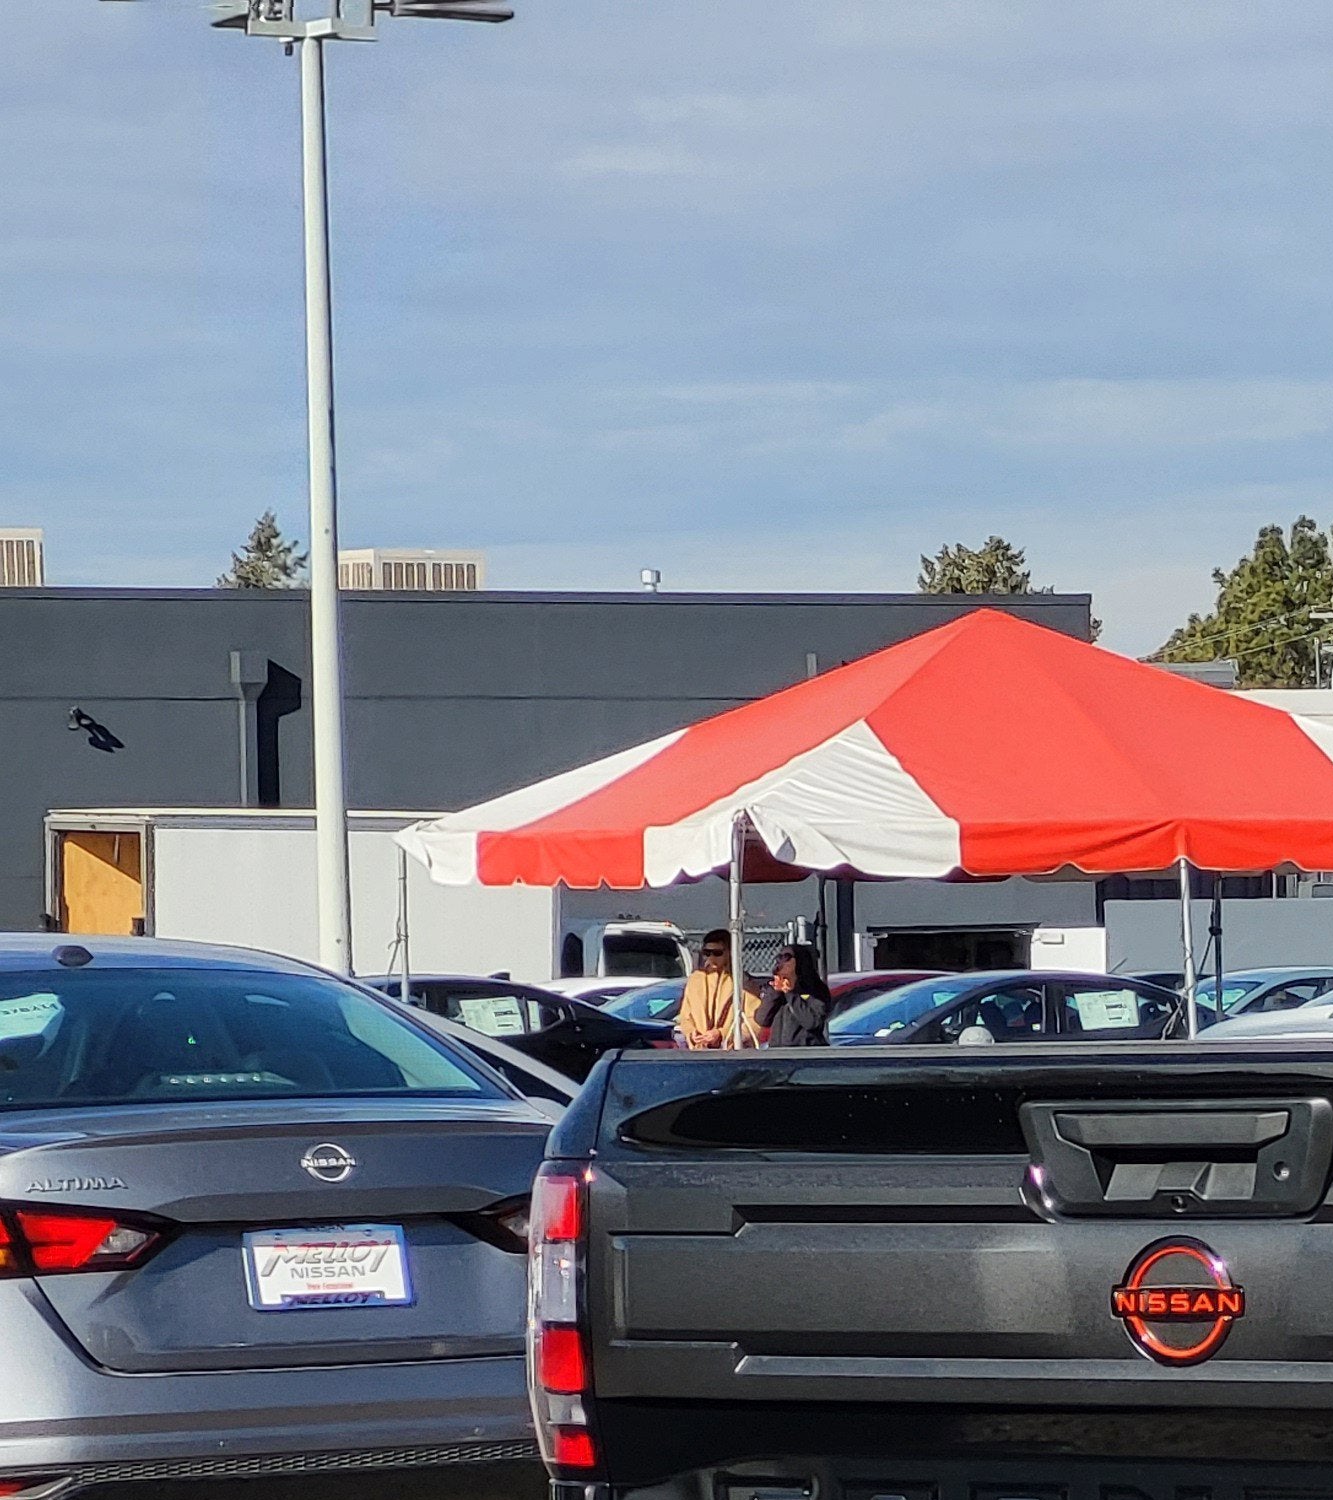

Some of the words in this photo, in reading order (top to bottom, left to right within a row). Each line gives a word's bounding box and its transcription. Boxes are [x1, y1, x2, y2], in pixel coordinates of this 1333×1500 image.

[300, 1157, 356, 1169] NISSAN
[25, 1176, 129, 1193] ALTIMA
[261, 1239, 392, 1277] MELLOY
[290, 1265, 366, 1279] NISSAN
[1116, 1292, 1241, 1314] NISSAN
